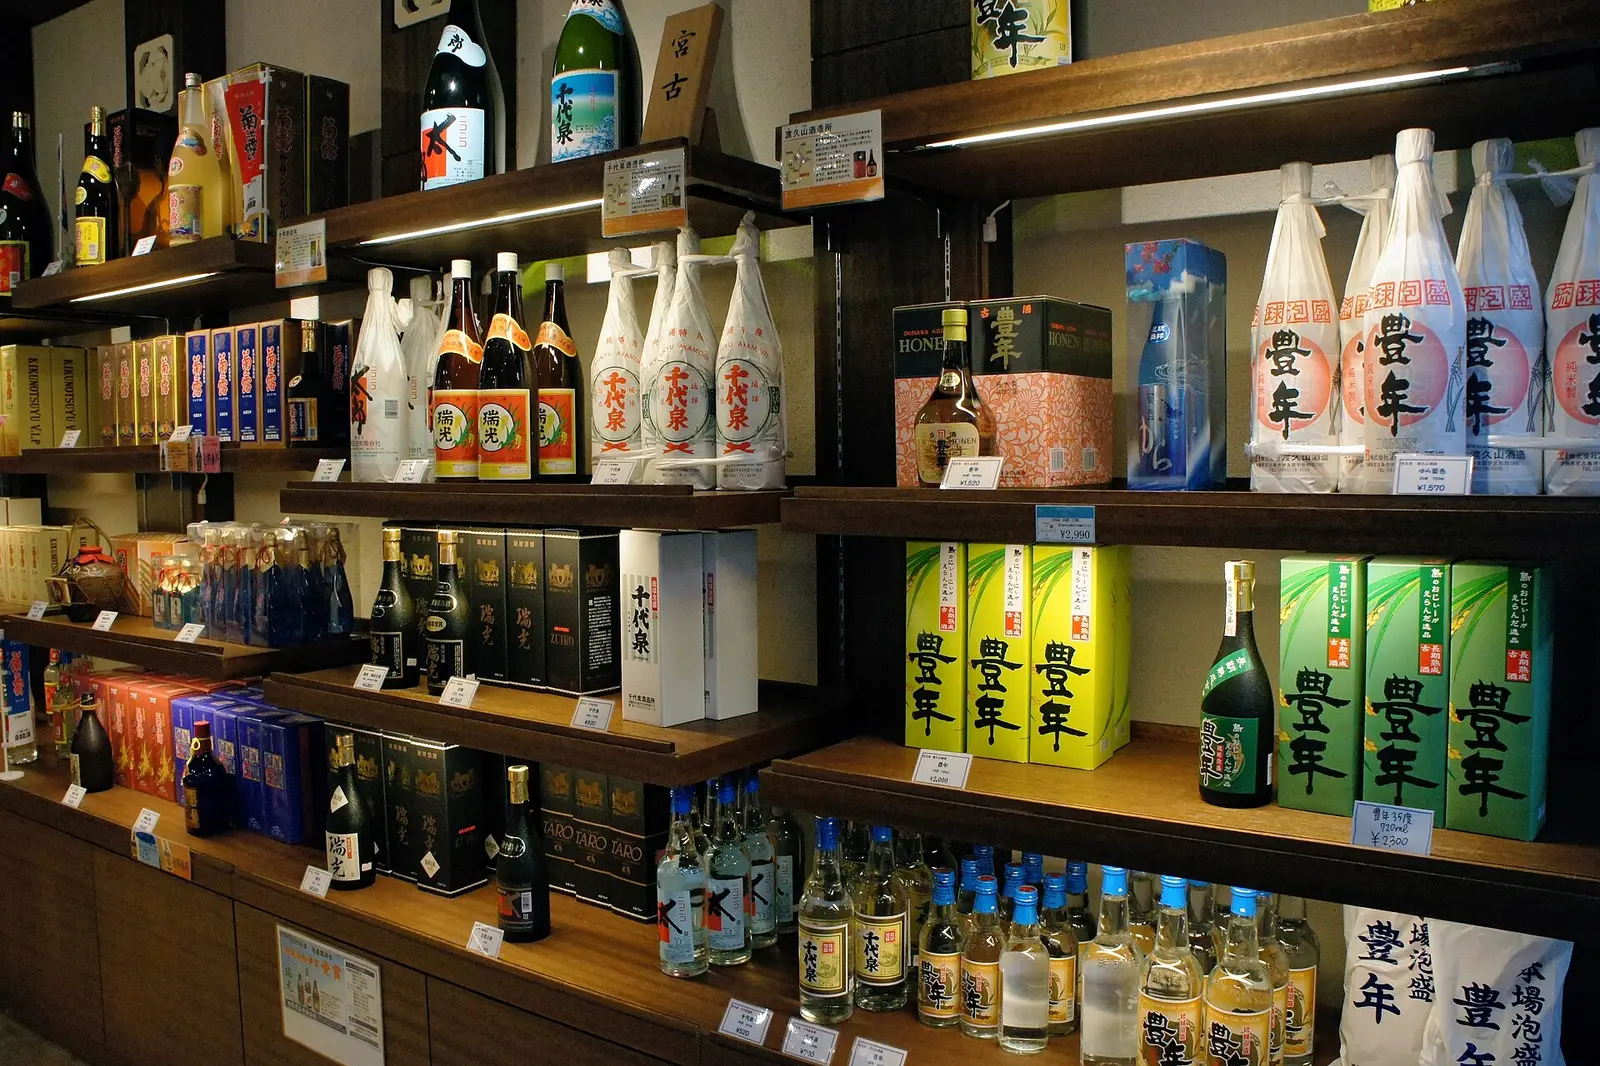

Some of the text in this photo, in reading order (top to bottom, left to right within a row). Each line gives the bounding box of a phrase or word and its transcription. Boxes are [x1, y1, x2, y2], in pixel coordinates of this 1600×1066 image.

[661, 30, 698, 102] 宮古
[555, 83, 575, 146] 千代泉
[980, 304, 1033, 318] 古 酒
[989, 306, 1023, 371] 豊年
[1049, 331, 1079, 347] HONEN
[899, 337, 944, 353] HONE
[1374, 312, 1429, 437] 豊年
[28, 357, 40, 421] KIKUNOTSUYU
[603, 371, 627, 432] 千代泉
[664, 366, 690, 432] 千代泉
[724, 364, 750, 432] 千代泉
[1265, 329, 1315, 440] 豊年
[1565, 361, 1577, 399] 純米製
[437, 409, 454, 443] 瑞光
[482, 409, 500, 445] 瑞光
[1060, 529, 1090, 540] ¥2,990
[631, 585, 650, 654] 千代泉
[908, 629, 958, 737] 豊年
[971, 635, 1024, 746] 豊年
[1036, 639, 1091, 752] 豊年
[1284, 666, 1351, 795] 豊年
[1371, 673, 1443, 806] 豊年
[1456, 679, 1532, 818] 豊年
[328, 835, 346, 878] 瑞光
[543, 820, 574, 840] TARO
[575, 830, 608, 851] TARO
[611, 840, 643, 862] TARO
[803, 940, 818, 983] 千代泉
[863, 931, 880, 973] 千代泉
[1353, 920, 1404, 1024] 豊年
[1407, 922, 1436, 1003] 場泡盛
[921, 960, 953, 1010] 豊年
[1511, 961, 1546, 1066] 本場泡盛
